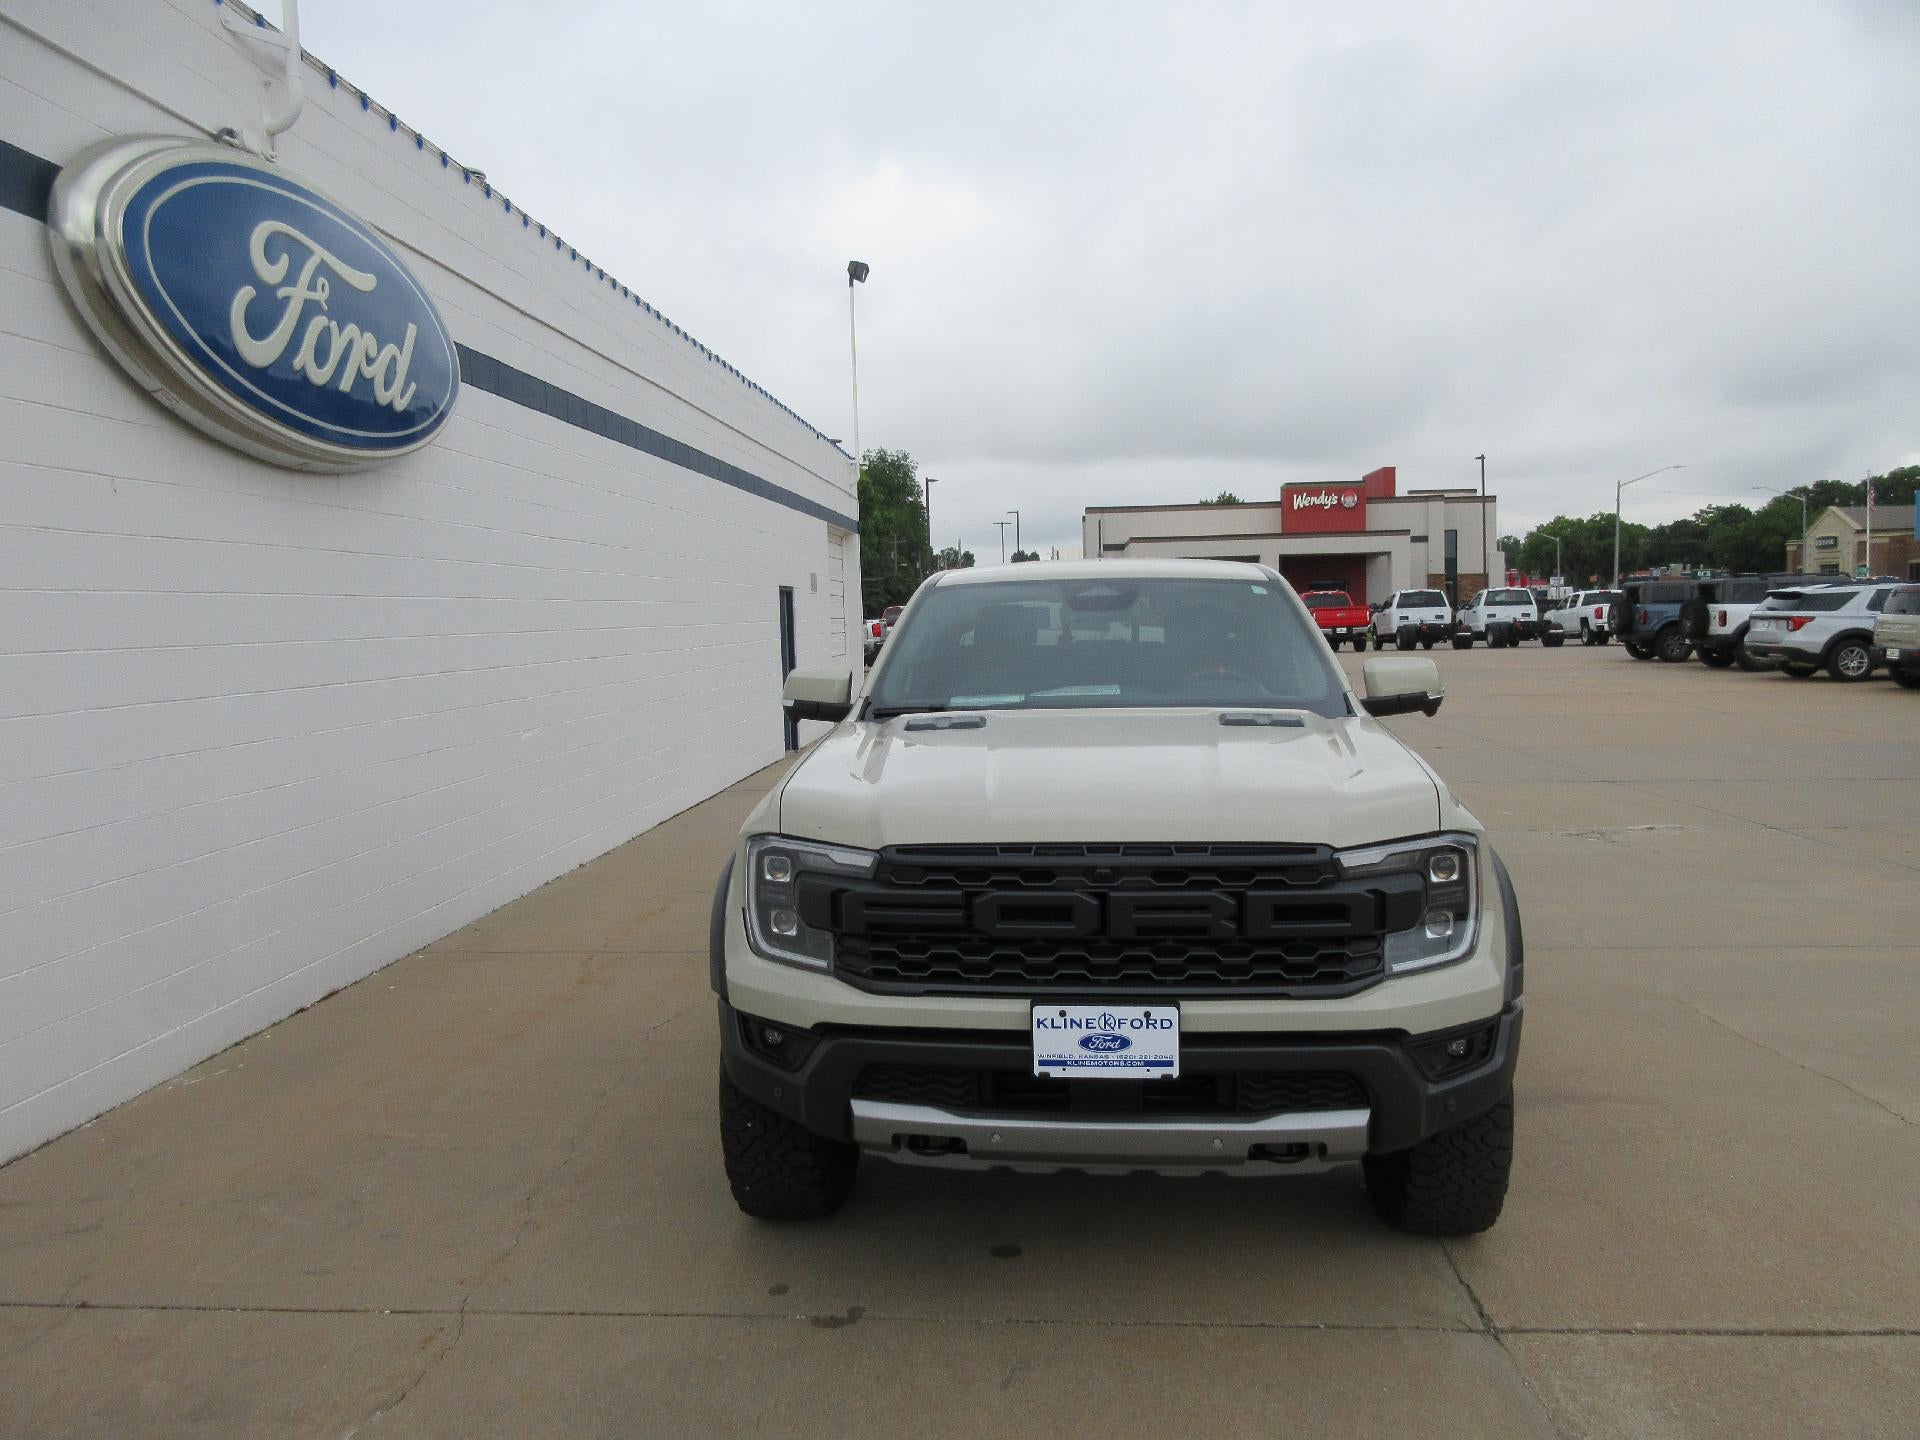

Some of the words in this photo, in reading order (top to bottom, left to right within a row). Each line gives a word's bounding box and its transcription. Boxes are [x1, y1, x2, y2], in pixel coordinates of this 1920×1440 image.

[231, 220, 418, 412] Ford
[1293, 490, 1338, 510] Wendy's
[838, 888, 1375, 937] FORD
[1036, 1017, 1097, 1030] KLINE
[1117, 1017, 1173, 1030] FORD
[1088, 1035, 1121, 1049] Ford
